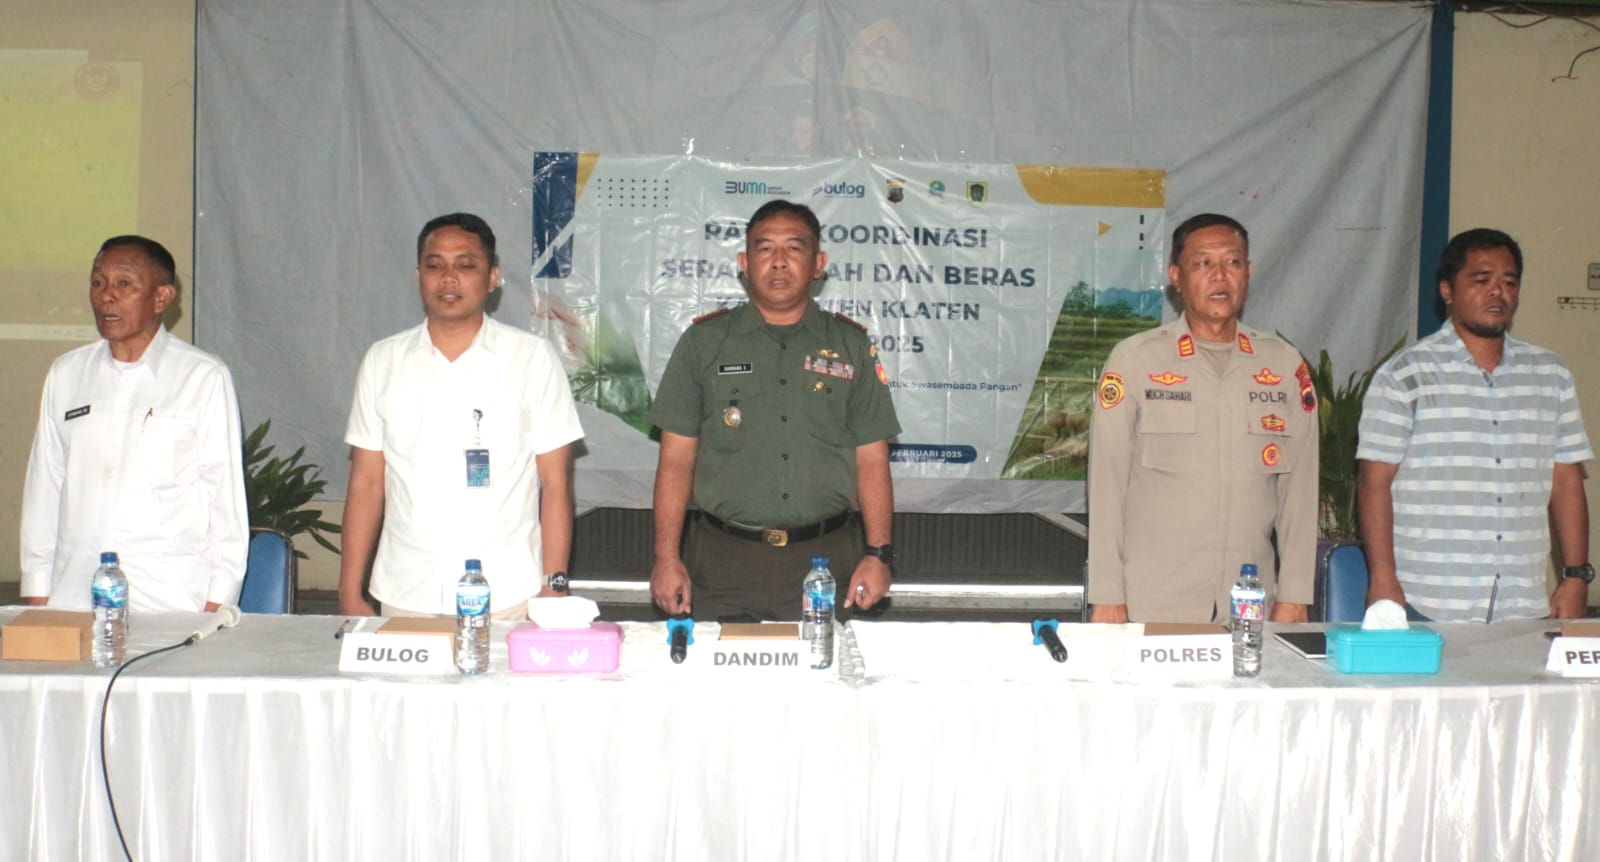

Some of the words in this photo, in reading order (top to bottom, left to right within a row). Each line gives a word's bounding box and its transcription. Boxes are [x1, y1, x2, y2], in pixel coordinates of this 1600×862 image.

[824, 181, 865, 198] bulog
[873, 263, 934, 283] DAN
[944, 266, 1036, 287] BERAS
[882, 300, 980, 320] KLATEN
[870, 334, 925, 352] 2025
[1249, 391, 1287, 404] POLRI
[940, 450, 963, 458] 2025
[356, 647, 430, 663] BULOG
[713, 652, 799, 666] DANDIM
[1140, 647, 1222, 663] POLRES
